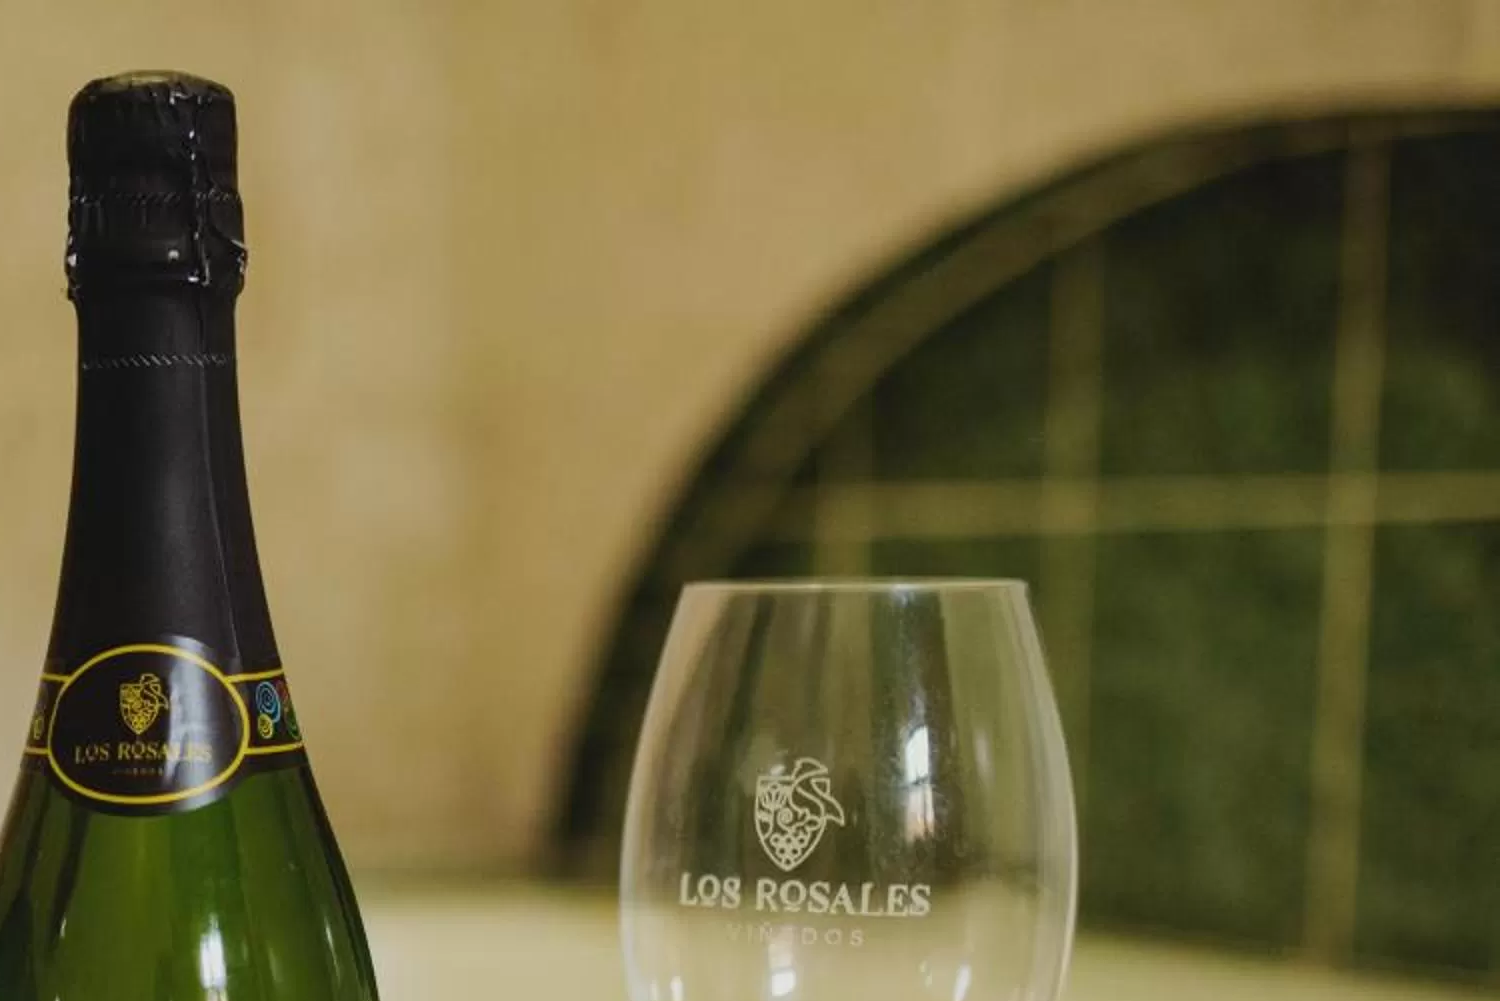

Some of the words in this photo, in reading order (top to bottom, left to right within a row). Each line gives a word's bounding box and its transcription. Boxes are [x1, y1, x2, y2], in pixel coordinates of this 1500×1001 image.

[75, 742, 110, 765] LOS
[678, 872, 741, 909] LOS
[755, 877, 932, 917] ROSALES
